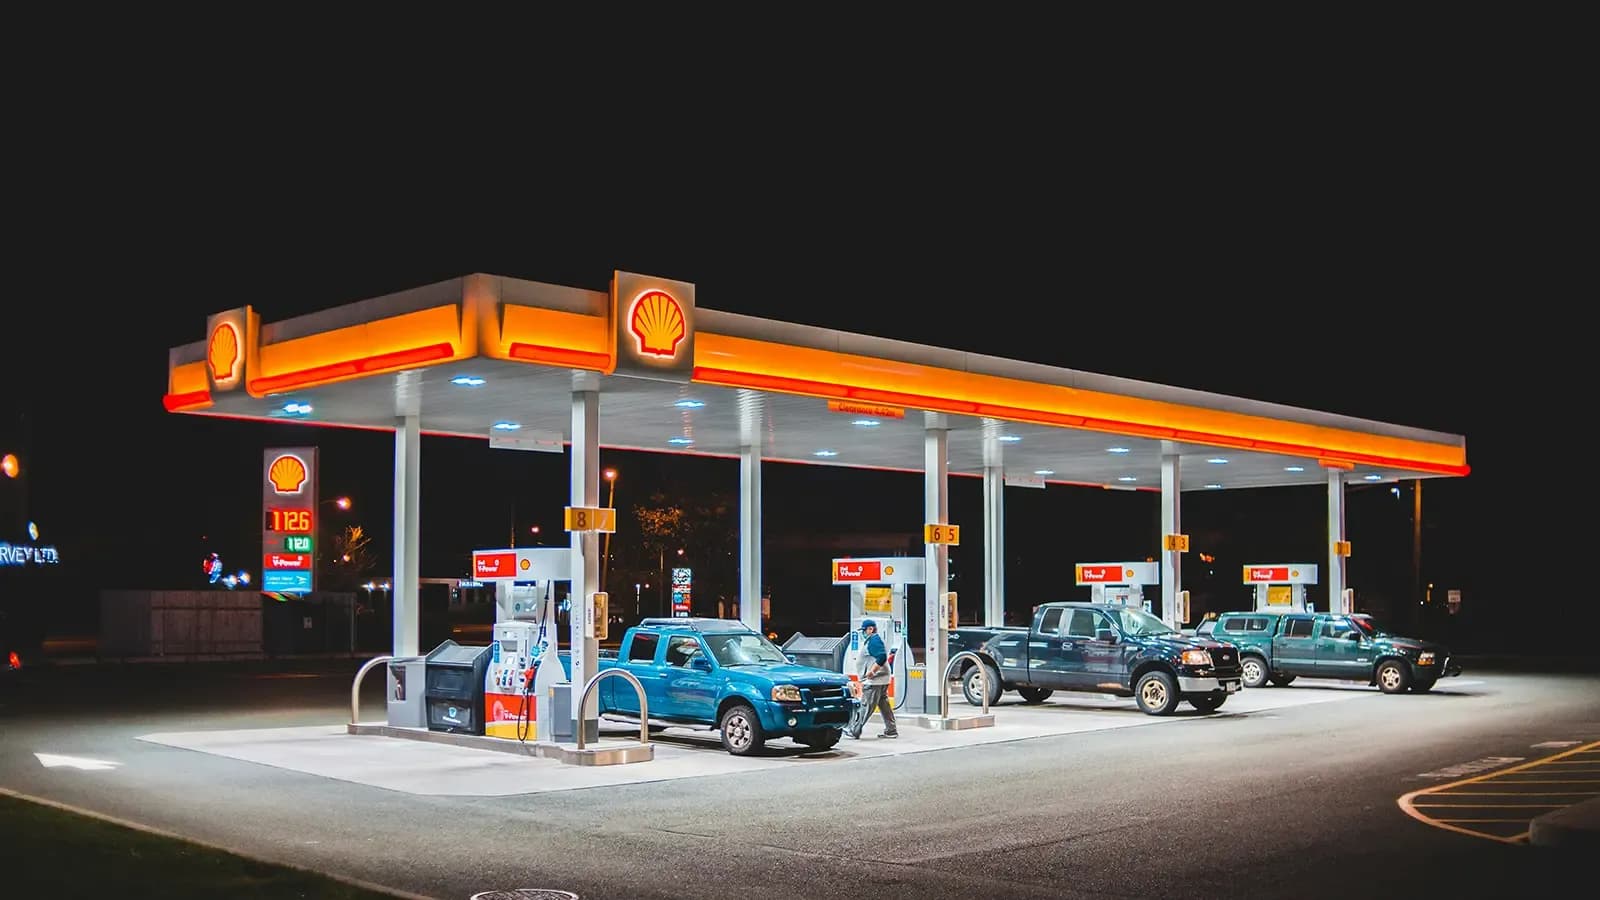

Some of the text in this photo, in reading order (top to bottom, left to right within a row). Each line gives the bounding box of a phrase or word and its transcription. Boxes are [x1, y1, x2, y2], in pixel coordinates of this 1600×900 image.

[577, 511, 586, 528] 8
[934, 527, 955, 541] 6 5
